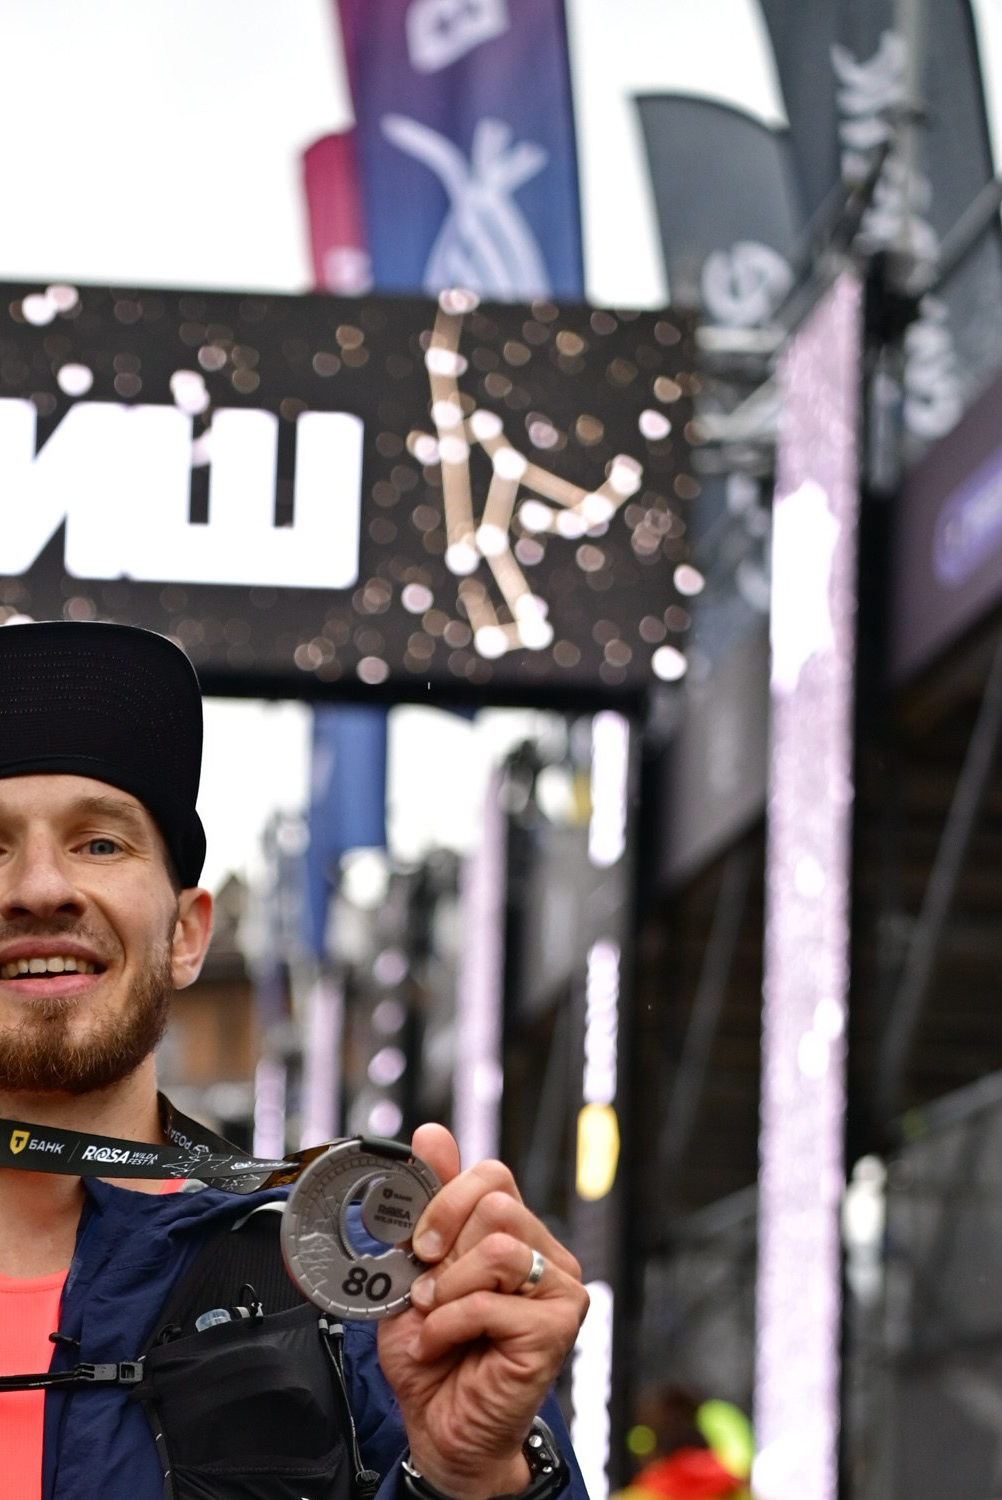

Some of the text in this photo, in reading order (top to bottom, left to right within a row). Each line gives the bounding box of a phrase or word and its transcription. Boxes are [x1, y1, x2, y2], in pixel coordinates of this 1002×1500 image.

[28, 1139, 65, 1155] БАНК
[81, 1145, 130, 1164] ROSA
[131, 1151, 155, 1160] WILD
[341, 1266, 392, 1301] 80
